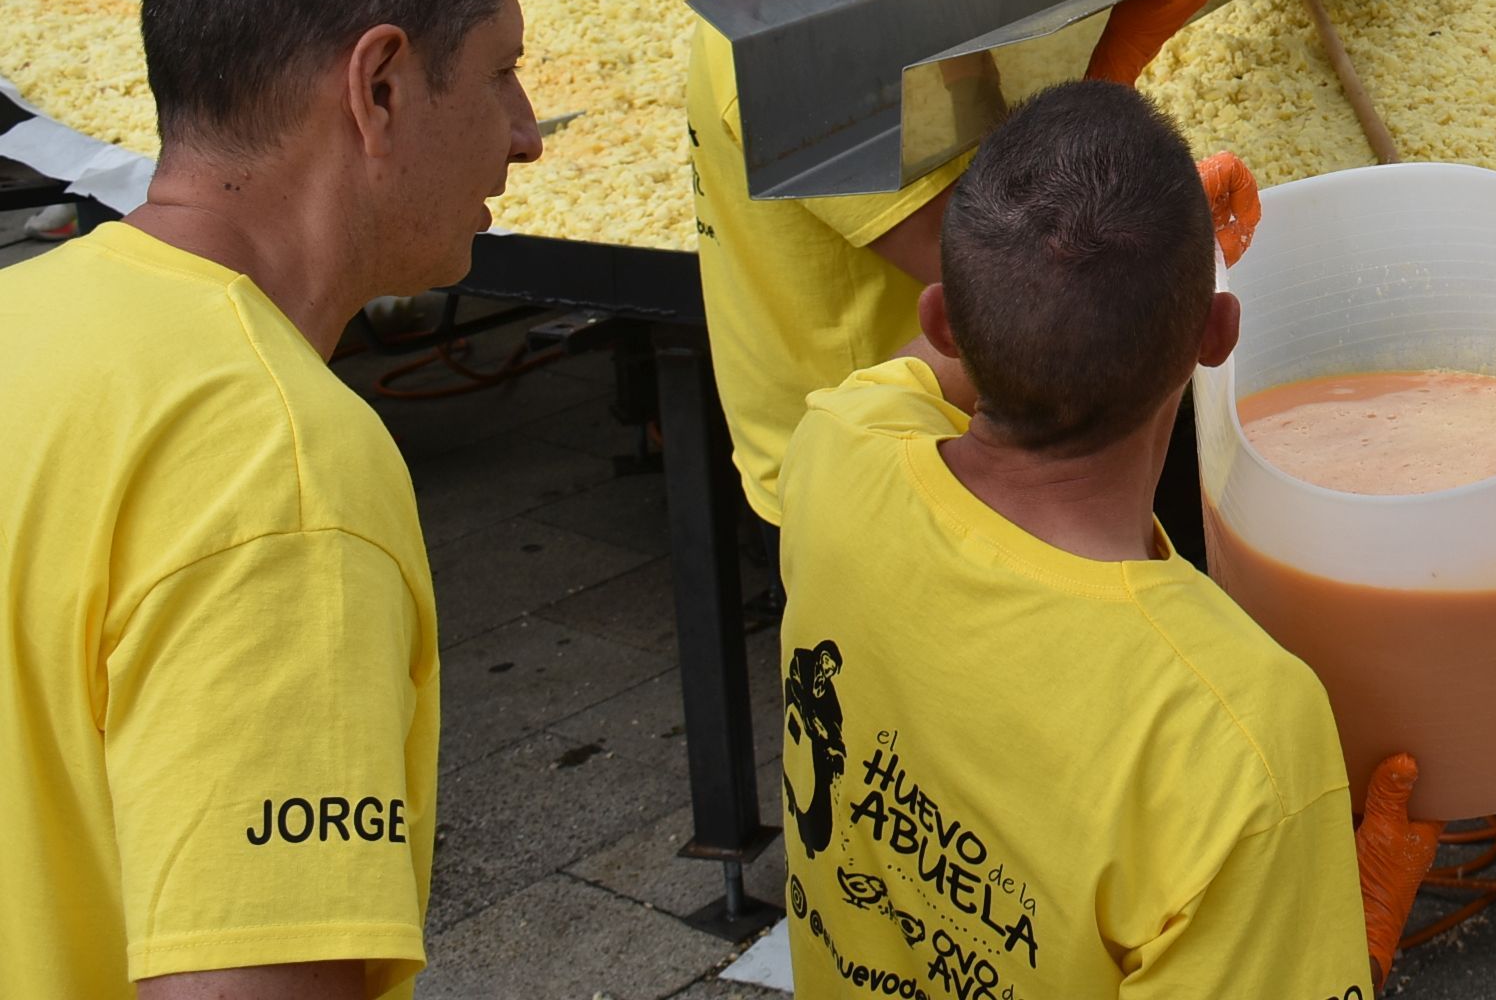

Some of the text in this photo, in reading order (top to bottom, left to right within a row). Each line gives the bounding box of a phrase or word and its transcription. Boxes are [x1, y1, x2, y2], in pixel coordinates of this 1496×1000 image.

[876, 729, 899, 752] el
[246, 796, 407, 846] JORGE
[862, 749, 1037, 917] HUEVO de la
[850, 790, 1039, 969] ABUELA
[932, 929, 999, 989] OVO
